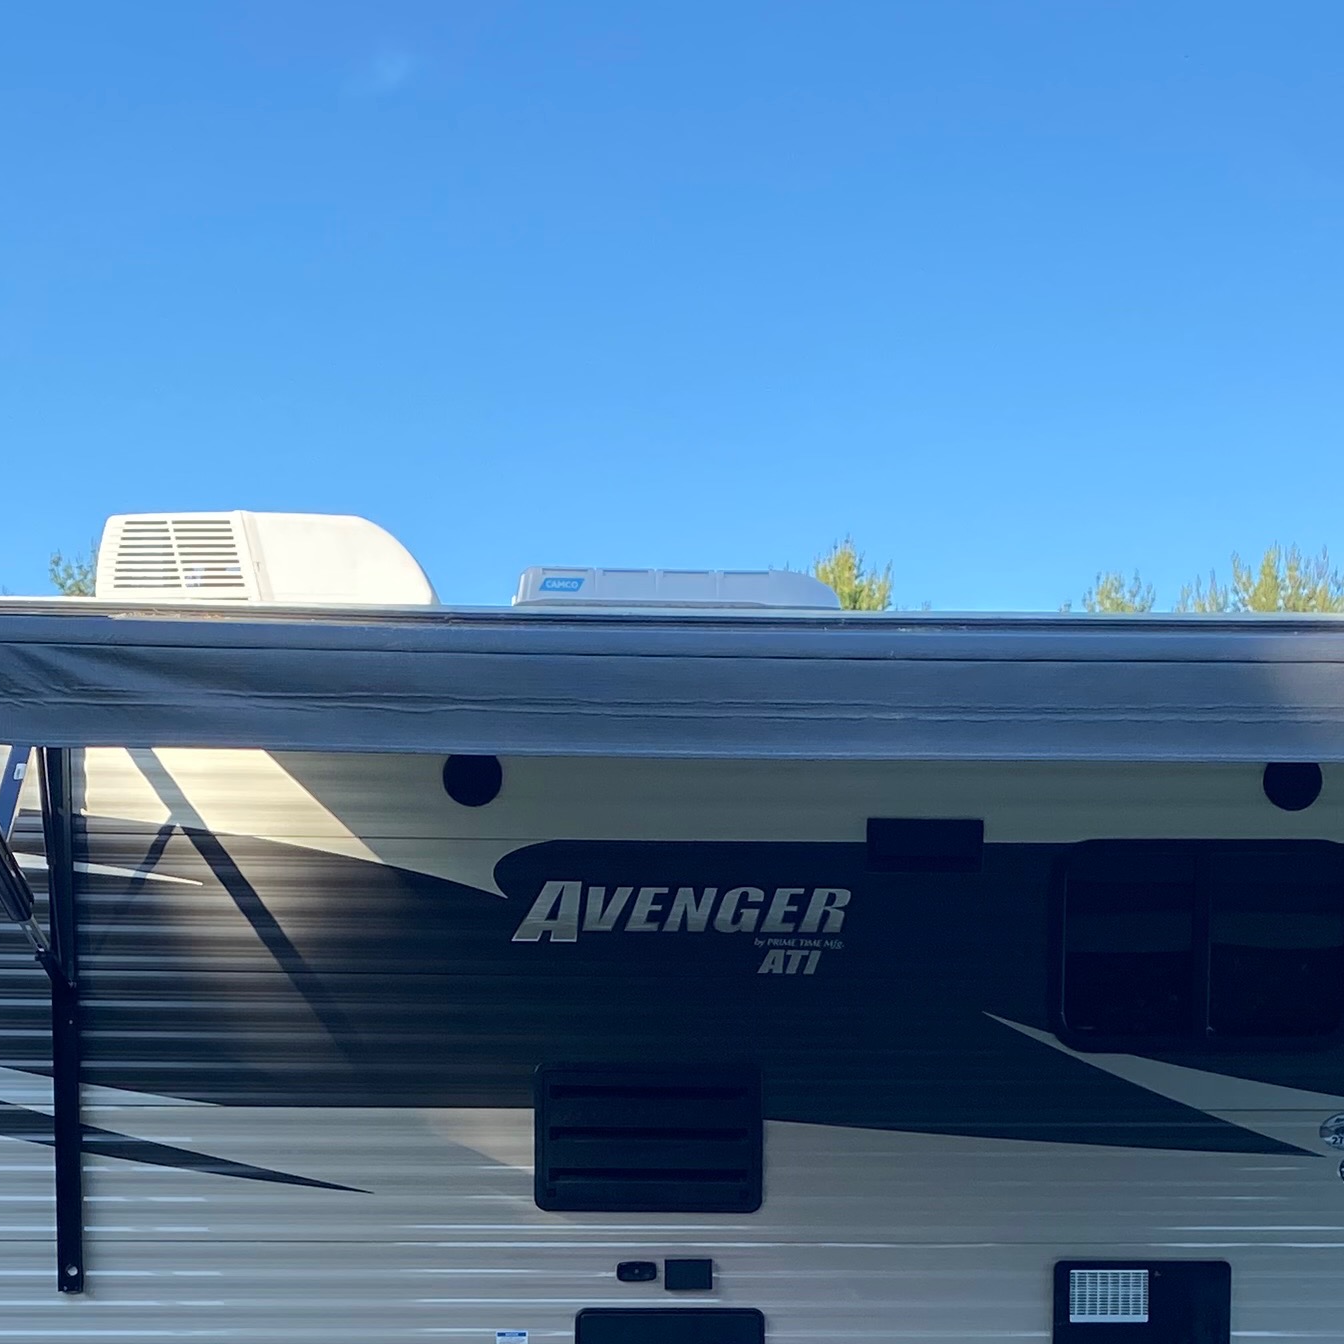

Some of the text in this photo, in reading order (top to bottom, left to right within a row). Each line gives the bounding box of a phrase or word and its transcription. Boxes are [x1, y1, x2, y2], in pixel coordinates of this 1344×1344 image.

[546, 580, 579, 589] CAMCO
[511, 881, 851, 942] AVENGER
[767, 938, 796, 947] PRIME
[799, 939, 823, 948] TIME
[757, 949, 822, 974] ATI
